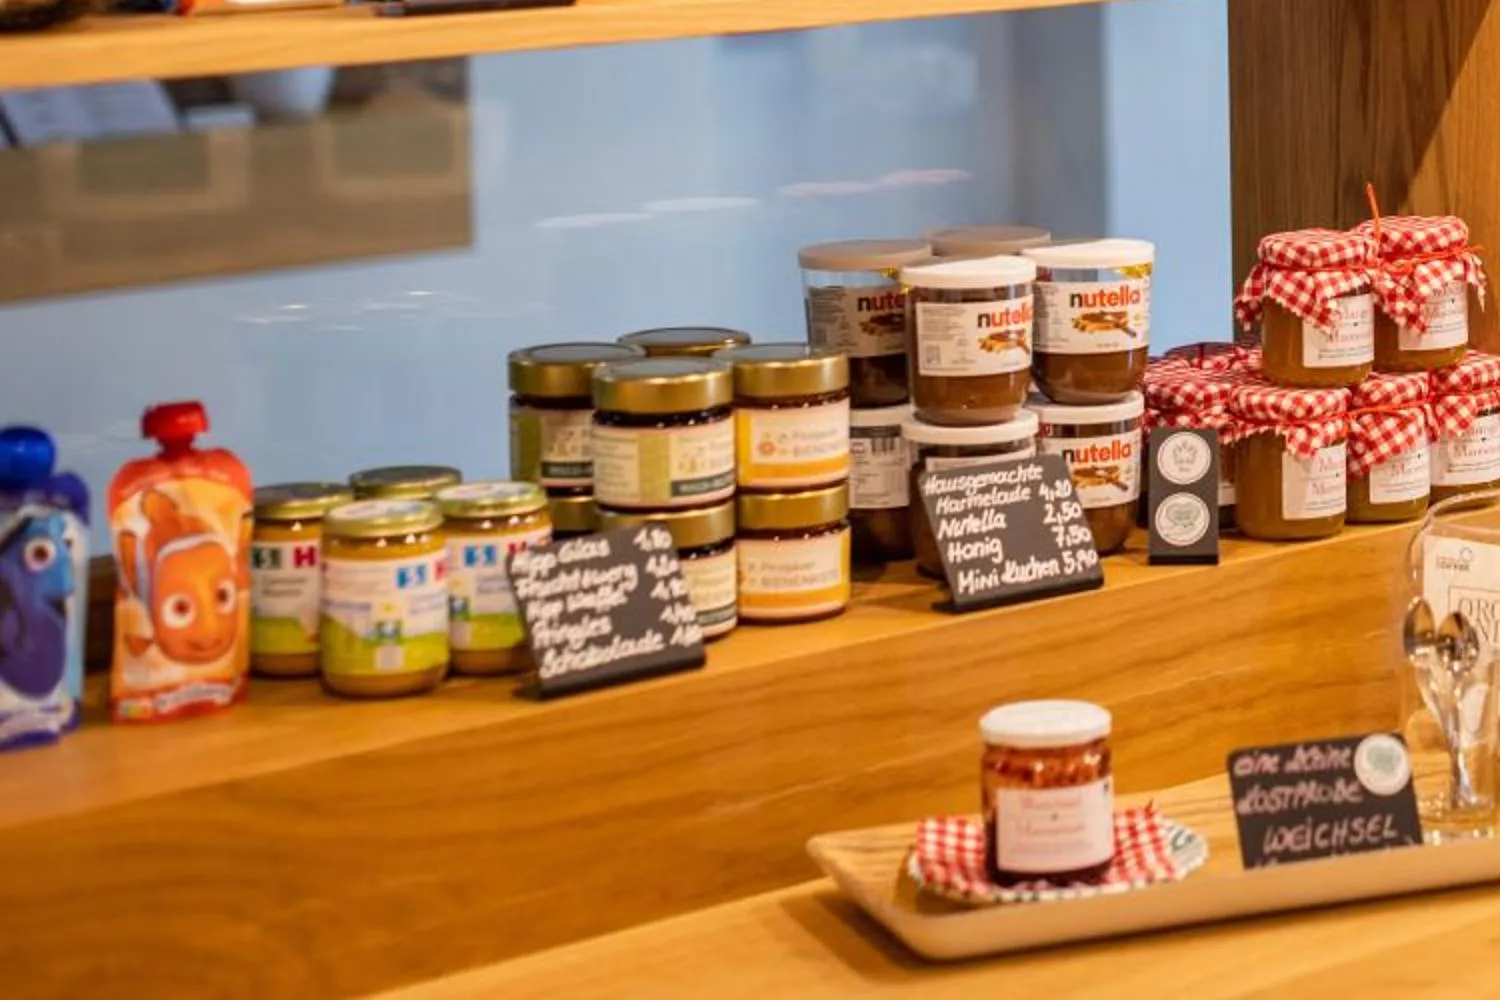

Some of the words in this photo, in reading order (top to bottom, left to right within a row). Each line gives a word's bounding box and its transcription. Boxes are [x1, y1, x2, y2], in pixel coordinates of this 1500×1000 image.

[1069, 285, 1141, 309] nutella
[1063, 439, 1133, 464] nutella
[923, 463, 1044, 496] Hausgemachte
[935, 484, 1032, 515] Marmelade
[937, 509, 1008, 540] Nutella
[1042, 502, 1083, 526] 2,50
[947, 537, 1005, 565] Honig
[1051, 524, 1093, 548] 7,50
[957, 567, 1000, 595] Mini
[1262, 813, 1399, 855] WEICHSEL
